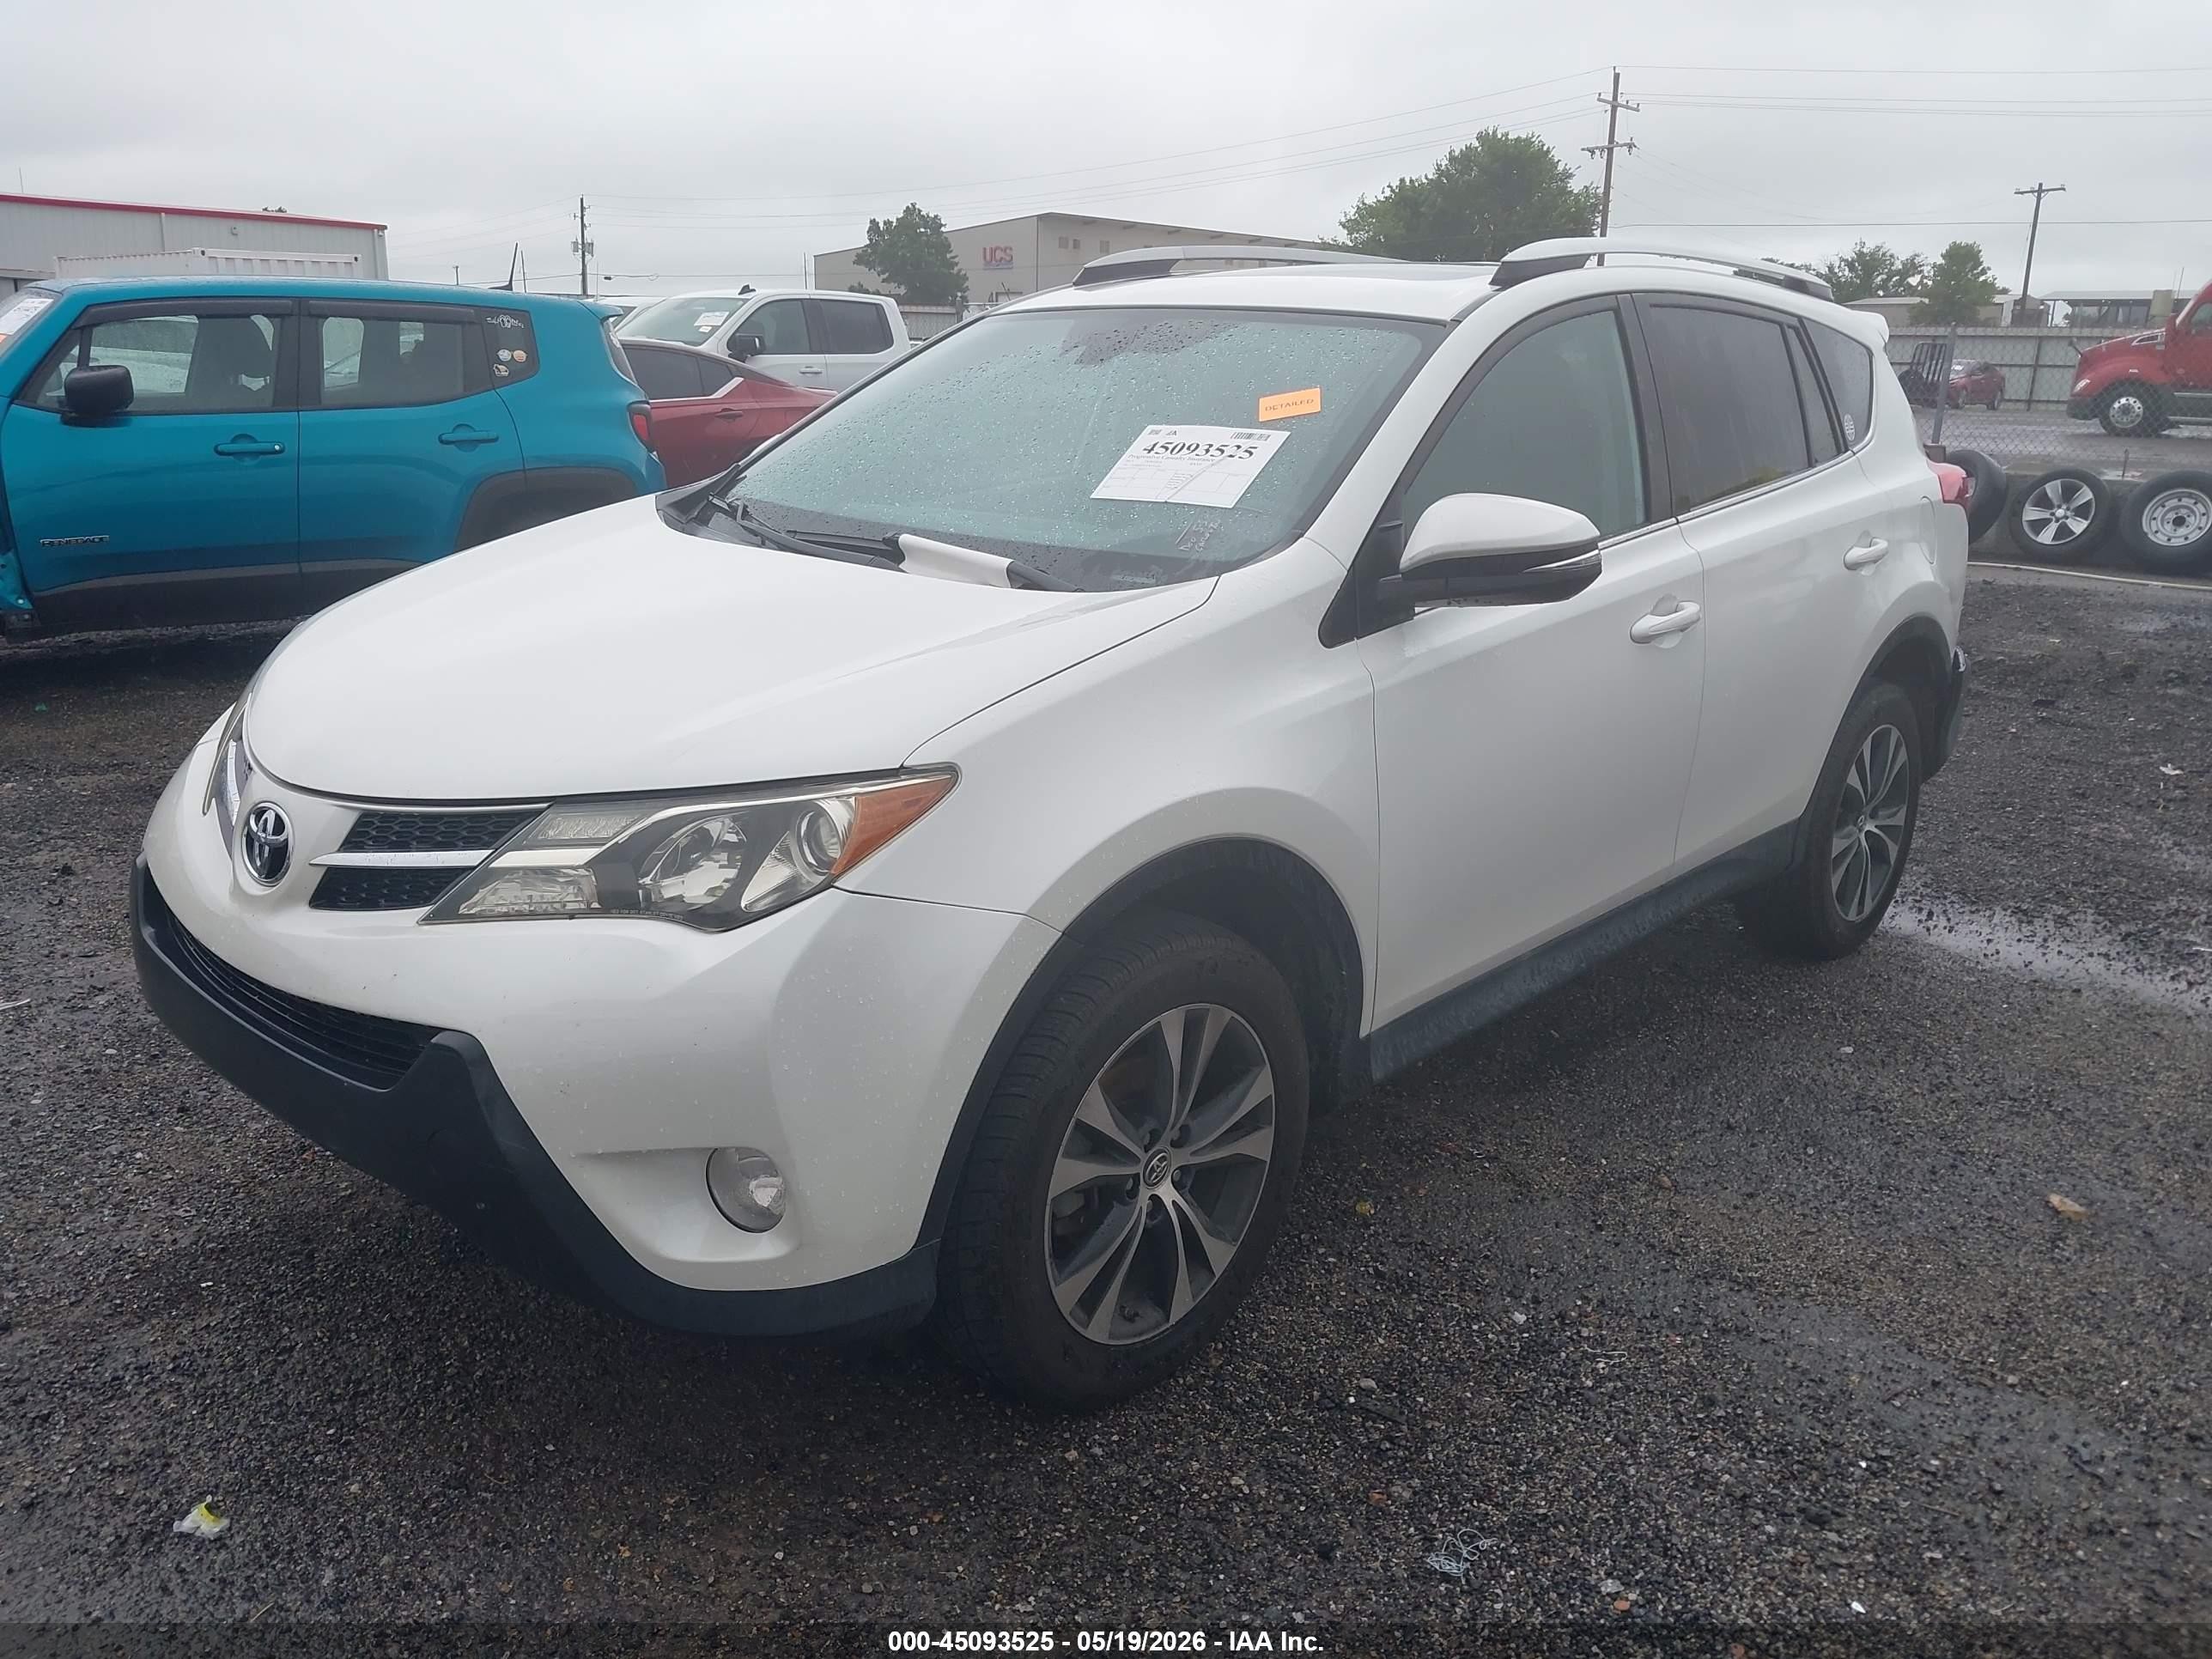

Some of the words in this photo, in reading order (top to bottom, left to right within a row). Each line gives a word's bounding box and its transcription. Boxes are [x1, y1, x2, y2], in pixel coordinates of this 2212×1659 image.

[982, 246, 1013, 263] UCS
[1142, 441, 1260, 460] 45093525
[40, 535, 110, 547] RENEGADE
